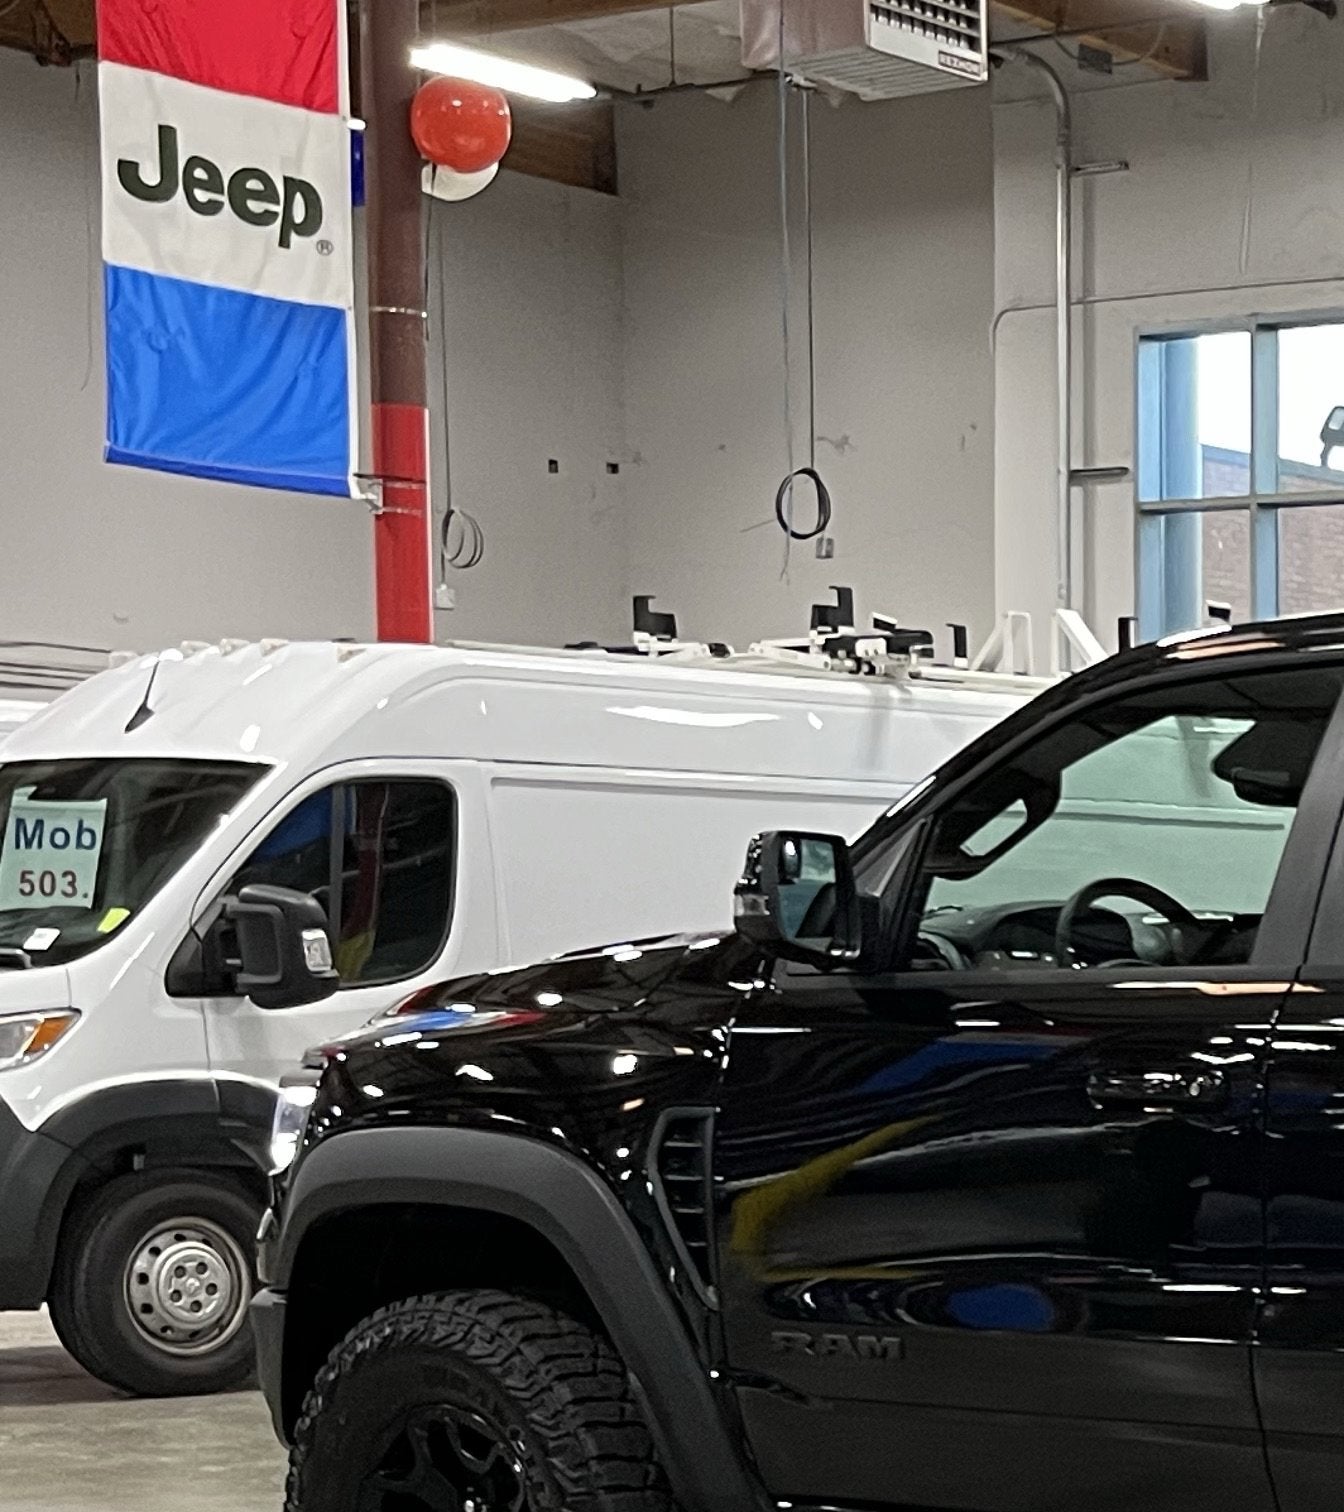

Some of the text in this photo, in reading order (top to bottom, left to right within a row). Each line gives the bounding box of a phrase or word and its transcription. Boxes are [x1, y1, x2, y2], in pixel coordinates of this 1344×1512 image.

[117, 124, 323, 250] Jeep
[15, 817, 97, 850] Mob
[770, 1331, 902, 1359] RAM
